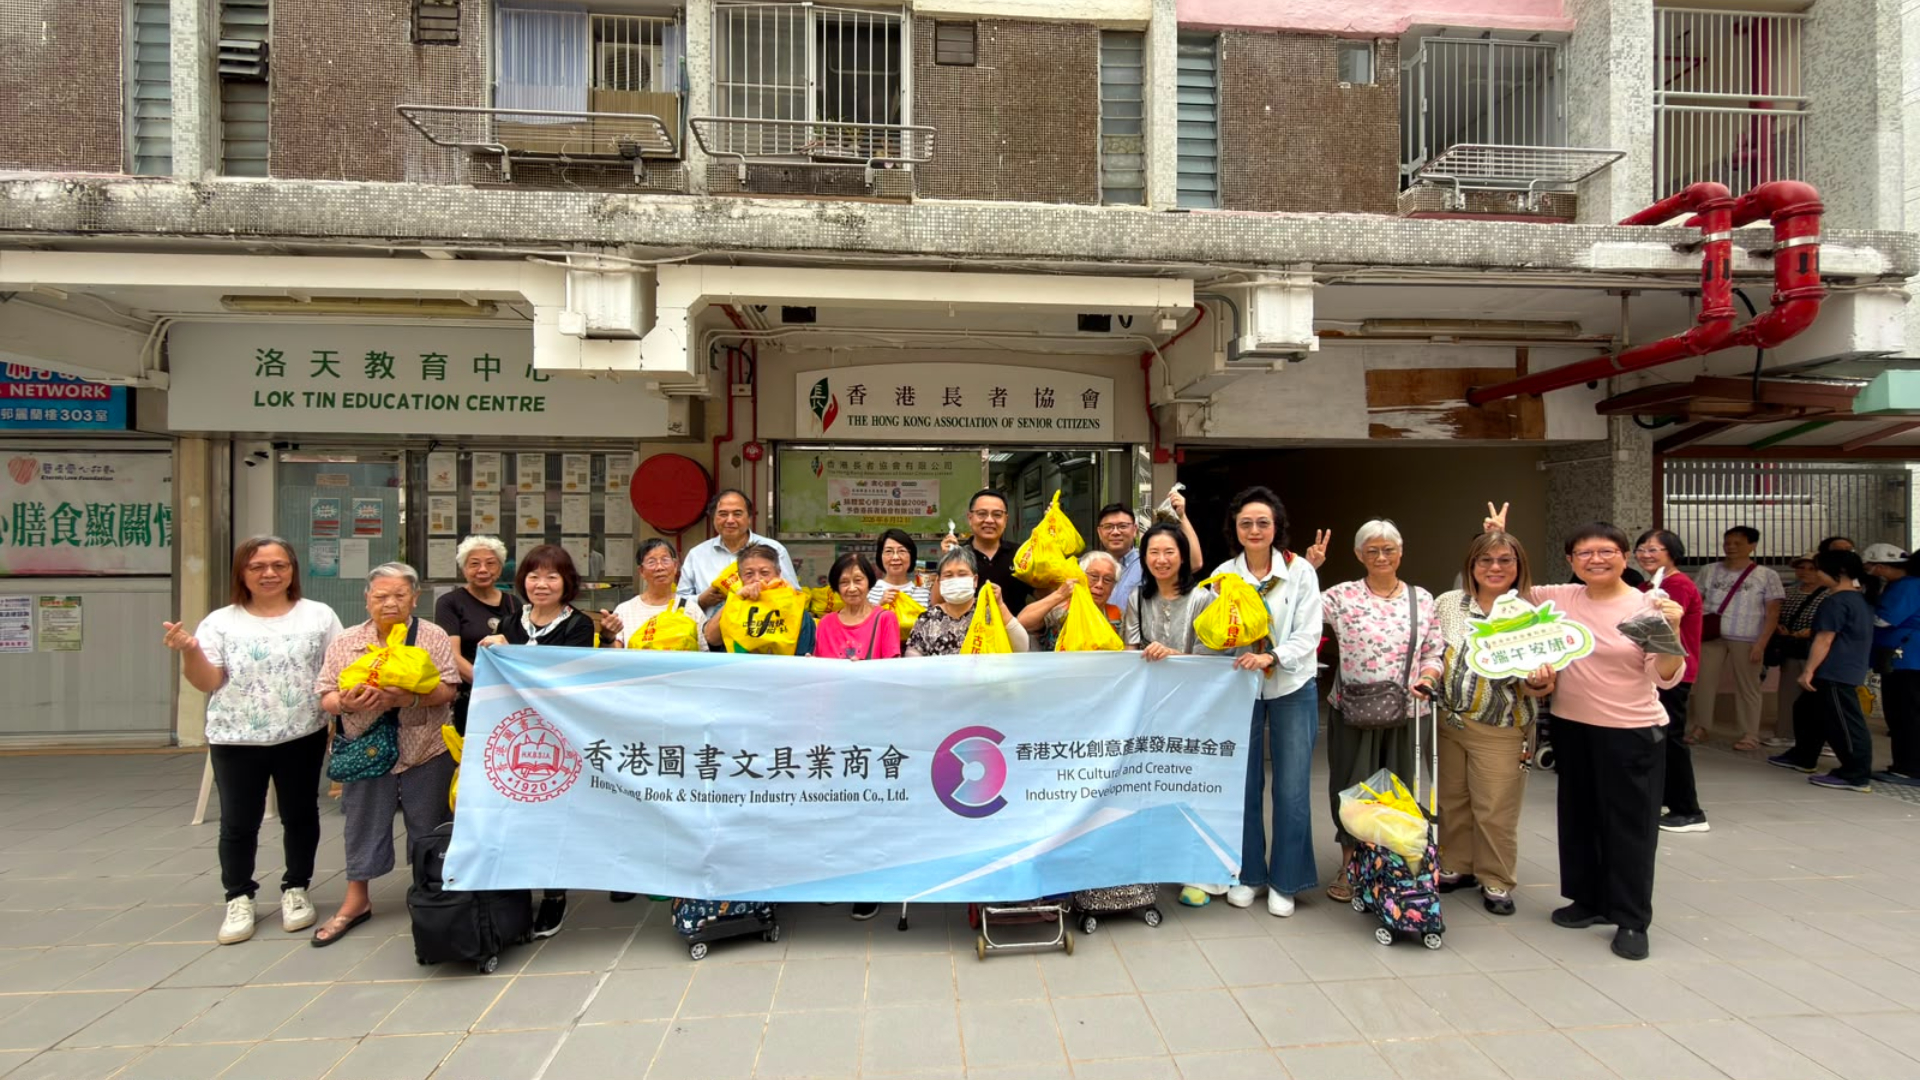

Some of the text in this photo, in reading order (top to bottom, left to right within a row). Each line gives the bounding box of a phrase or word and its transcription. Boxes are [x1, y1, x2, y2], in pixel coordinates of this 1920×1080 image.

[9, 383, 107, 398] NETWORK
[254, 390, 546, 412] LOK TIN EDUCATION CENTRE
[846, 384, 1100, 409] 香港長者協會
[847, 415, 1100, 429] THE HONG KONG ASSOCIATION OF SENIOR CITIZENS
[827, 461, 953, 470] 香港長者協會有限公司
[1490, 637, 1567, 666] 端午安康
[1016, 735, 1237, 760] 香港文化創意產業發展基金會
[583, 738, 910, 782] 香港圖書文具業商會
[1057, 768, 1075, 780] HK
[1122, 762, 1143, 775] and
[1145, 762, 1193, 774] Creative
[514, 780, 548, 793] 1920
[590, 775, 618, 793] Hong
[644, 787, 673, 802] Book
[676, 788, 687, 802] &
[690, 788, 747, 807] Stationery
[750, 789, 797, 806] Industry
[800, 789, 860, 802] Association
[863, 789, 884, 804] Co.,
[887, 788, 909, 802] Ltd.
[1026, 780, 1222, 803] Industry Development Foundation
